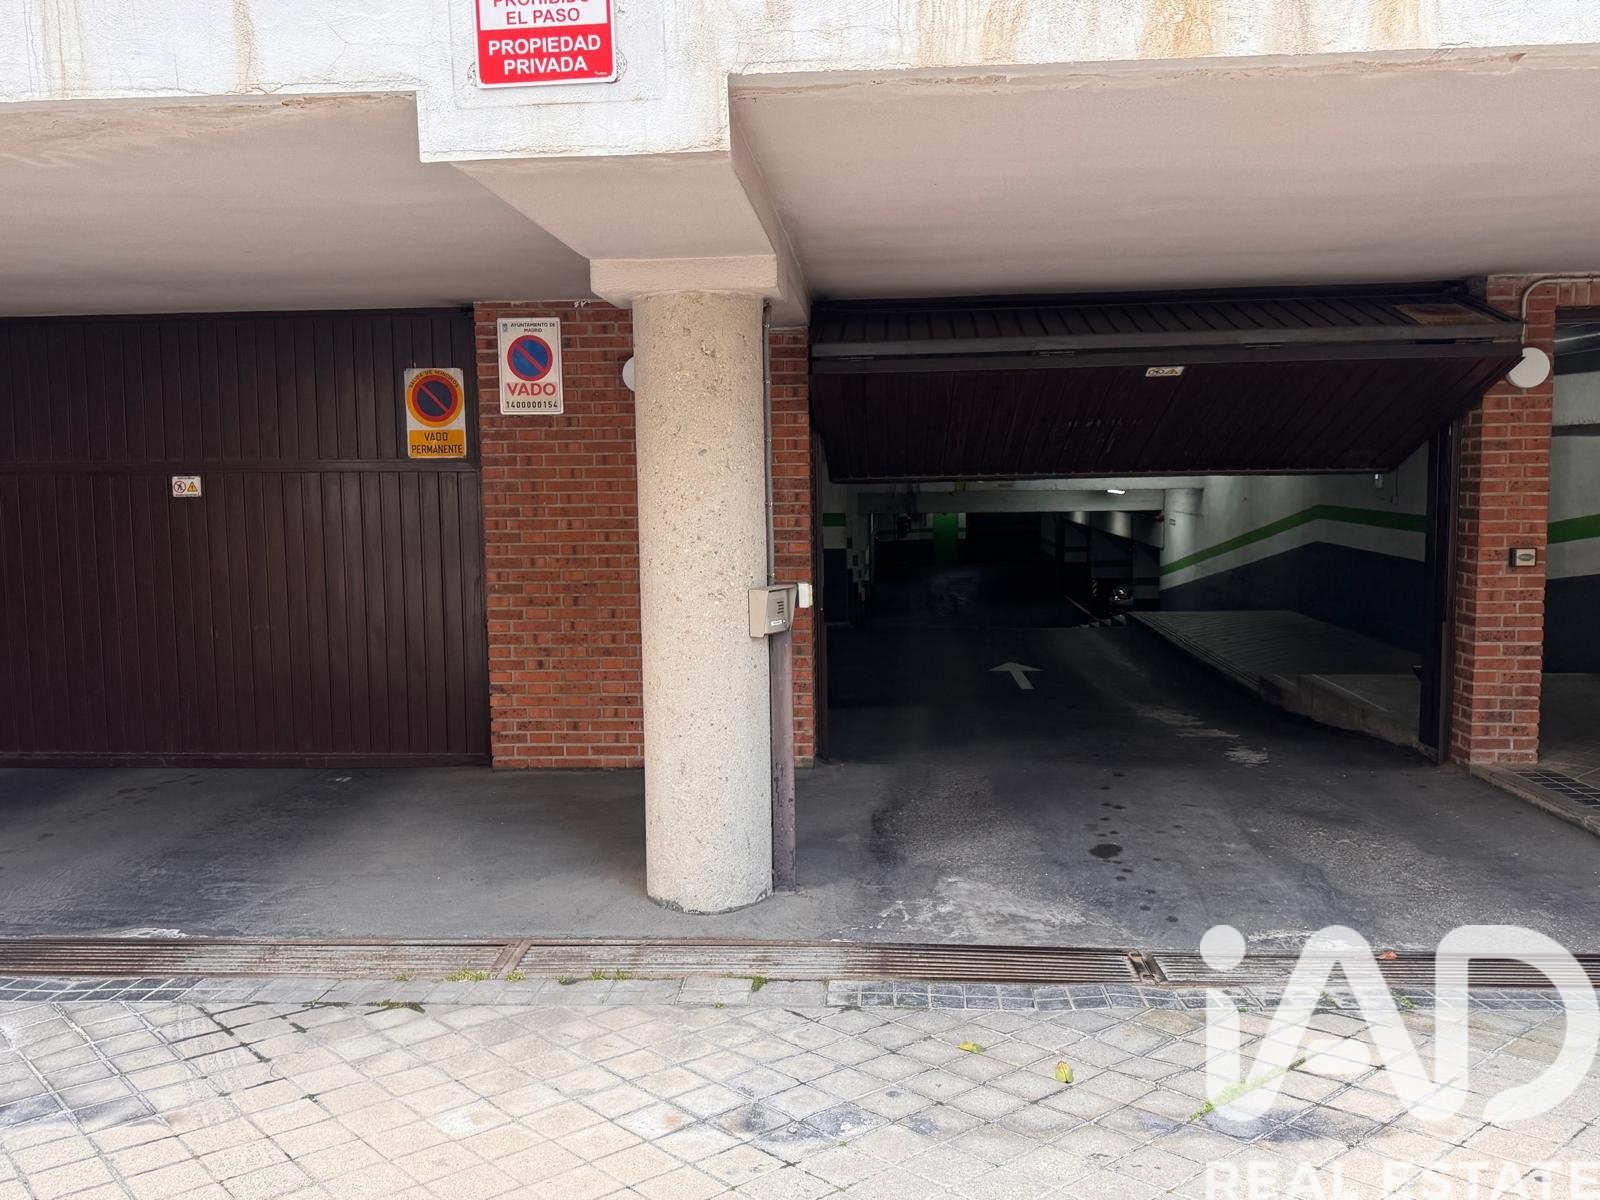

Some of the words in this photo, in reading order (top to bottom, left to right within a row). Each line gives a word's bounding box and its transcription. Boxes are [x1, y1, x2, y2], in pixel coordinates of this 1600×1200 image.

[506, 11, 528, 25] EL
[533, 8, 580, 23] PASO
[488, 34, 601, 56] PROPIEDAD
[504, 55, 588, 75] PRIVADA
[507, 383, 556, 396] VADO
[424, 432, 448, 441] VADO
[411, 444, 463, 454] PERMANENTE
